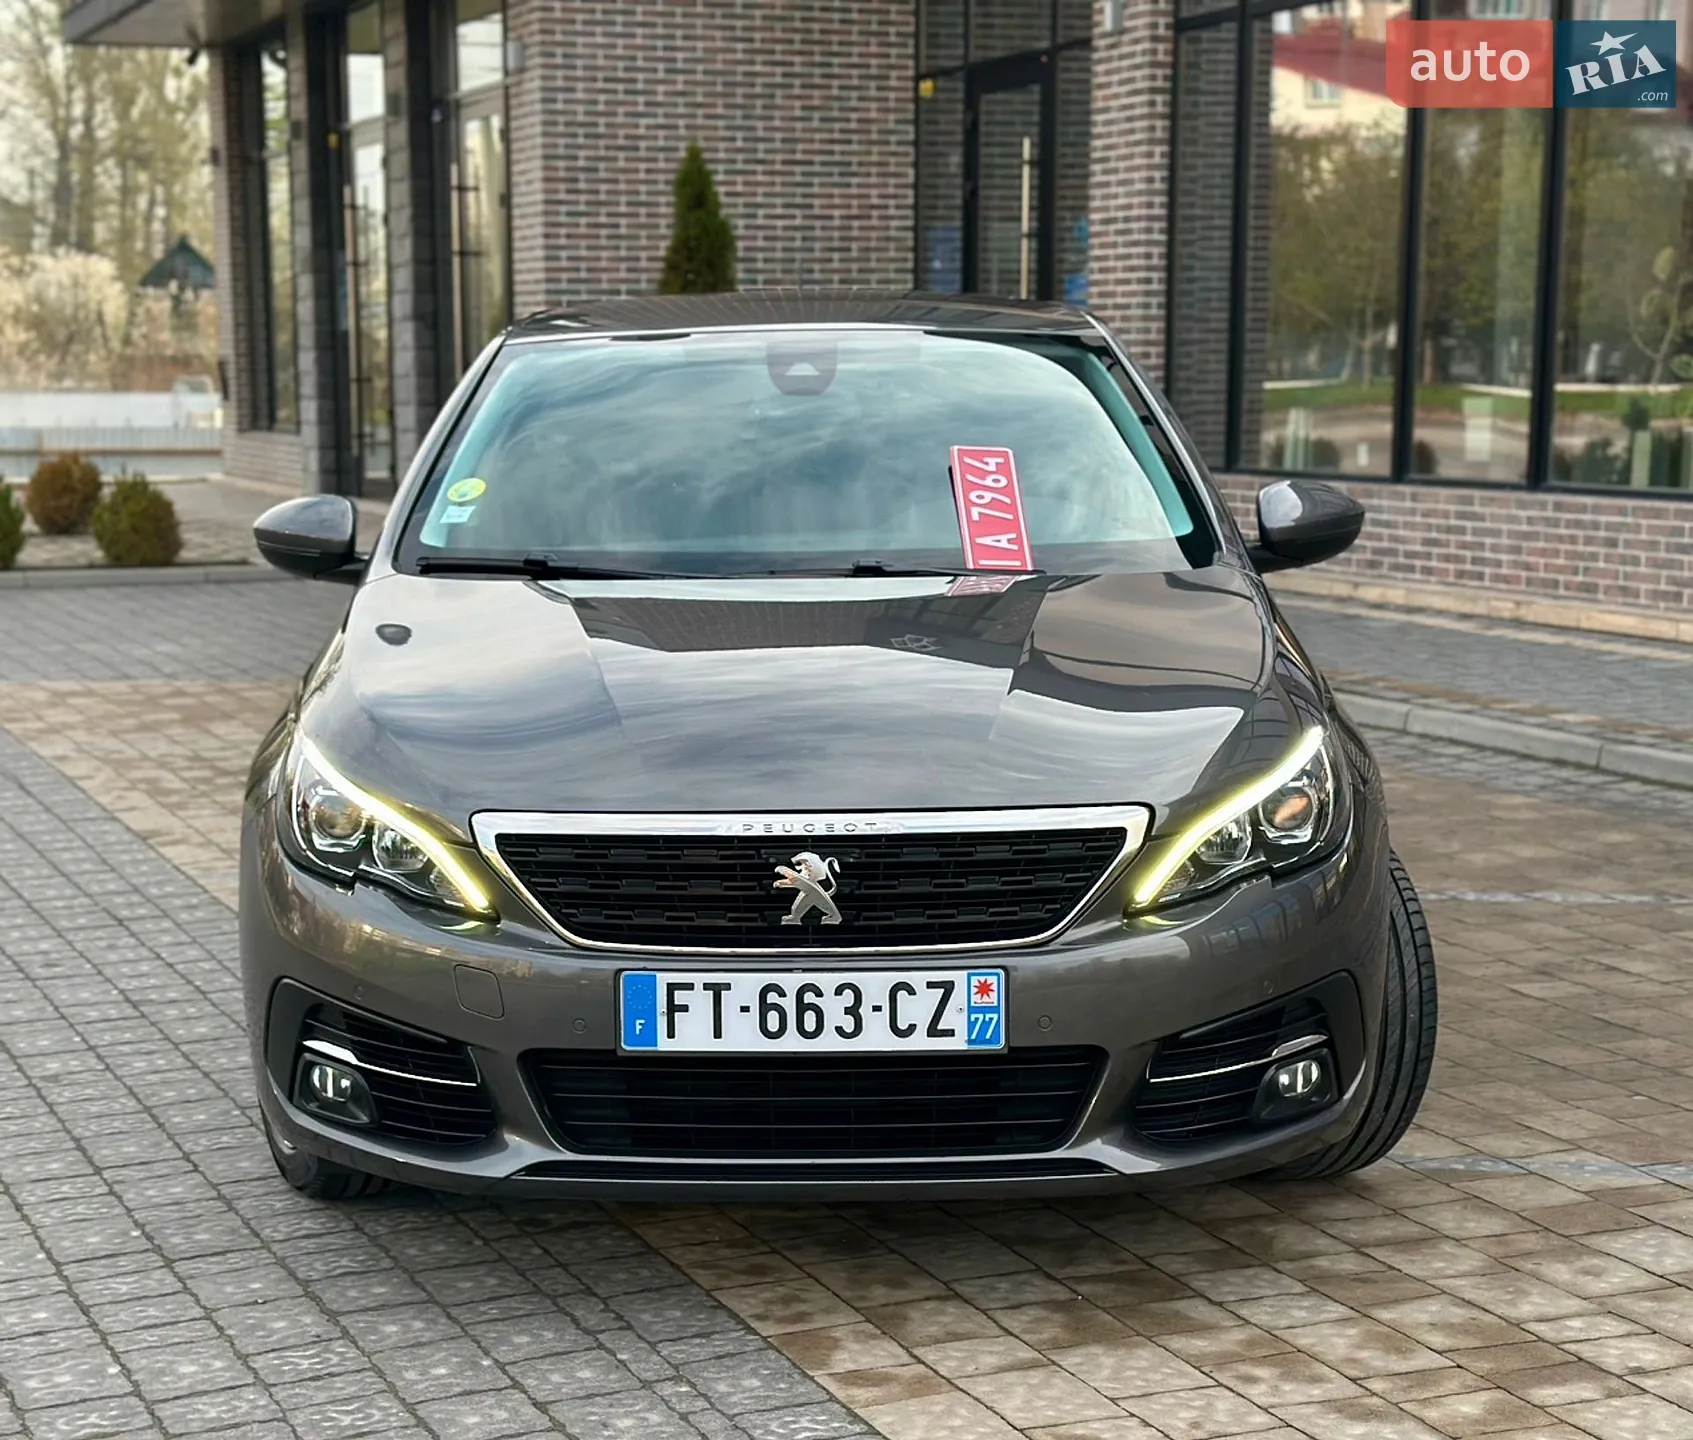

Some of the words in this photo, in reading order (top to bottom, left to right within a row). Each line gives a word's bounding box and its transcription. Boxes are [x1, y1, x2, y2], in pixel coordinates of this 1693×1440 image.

[962, 456, 1015, 522] 7964
[742, 822, 878, 833] PEUGEOT
[666, 980, 957, 1040] FT-663-CZ
[635, 1020, 645, 1035] F
[970, 1013, 999, 1040] 77
